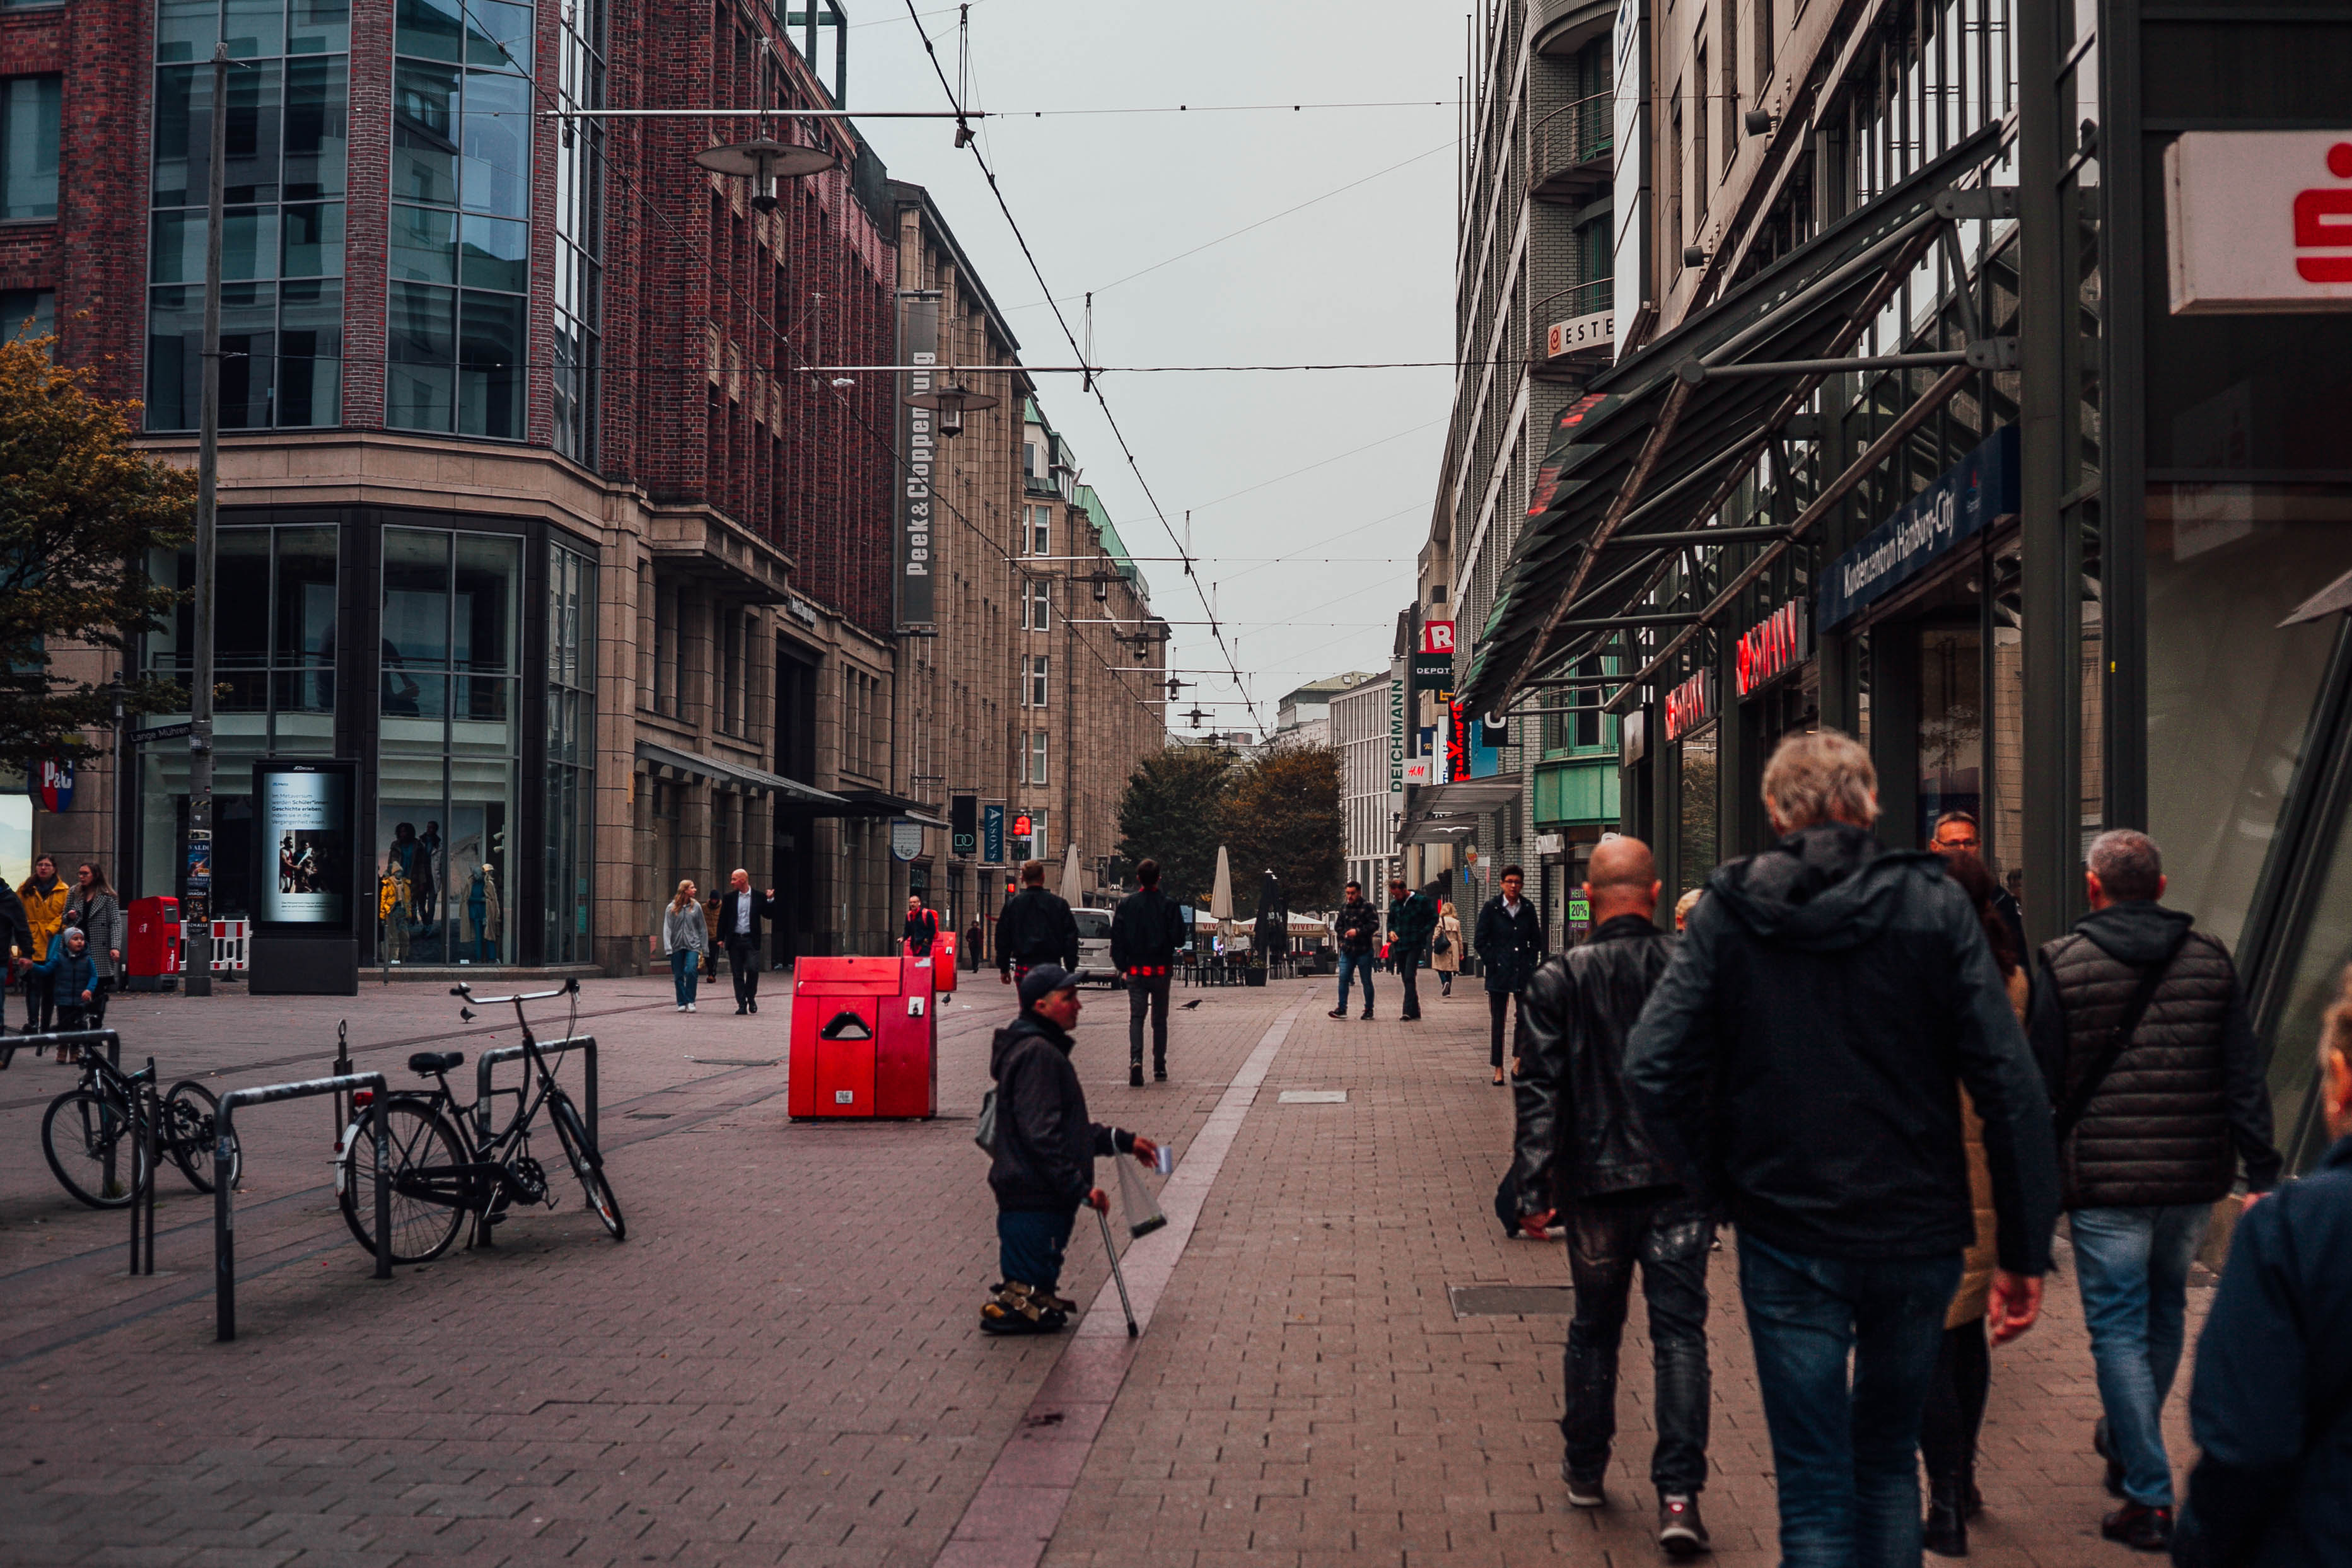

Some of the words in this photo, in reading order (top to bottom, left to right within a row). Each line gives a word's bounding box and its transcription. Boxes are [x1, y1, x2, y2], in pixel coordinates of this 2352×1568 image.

[1566, 318, 1614, 345] ESTE
[907, 518, 929, 575] Peek
[1844, 538, 1896, 598] Kundenzentrum
[1897, 489, 1955, 561] Hamburg-City
[131, 731, 156, 741] Lange
[158, 726, 189, 737] Mühren
[1391, 680, 1403, 793] DEICHMANN
[1407, 766, 1424, 777] H&M
[1571, 903, 1587, 917] 20%
